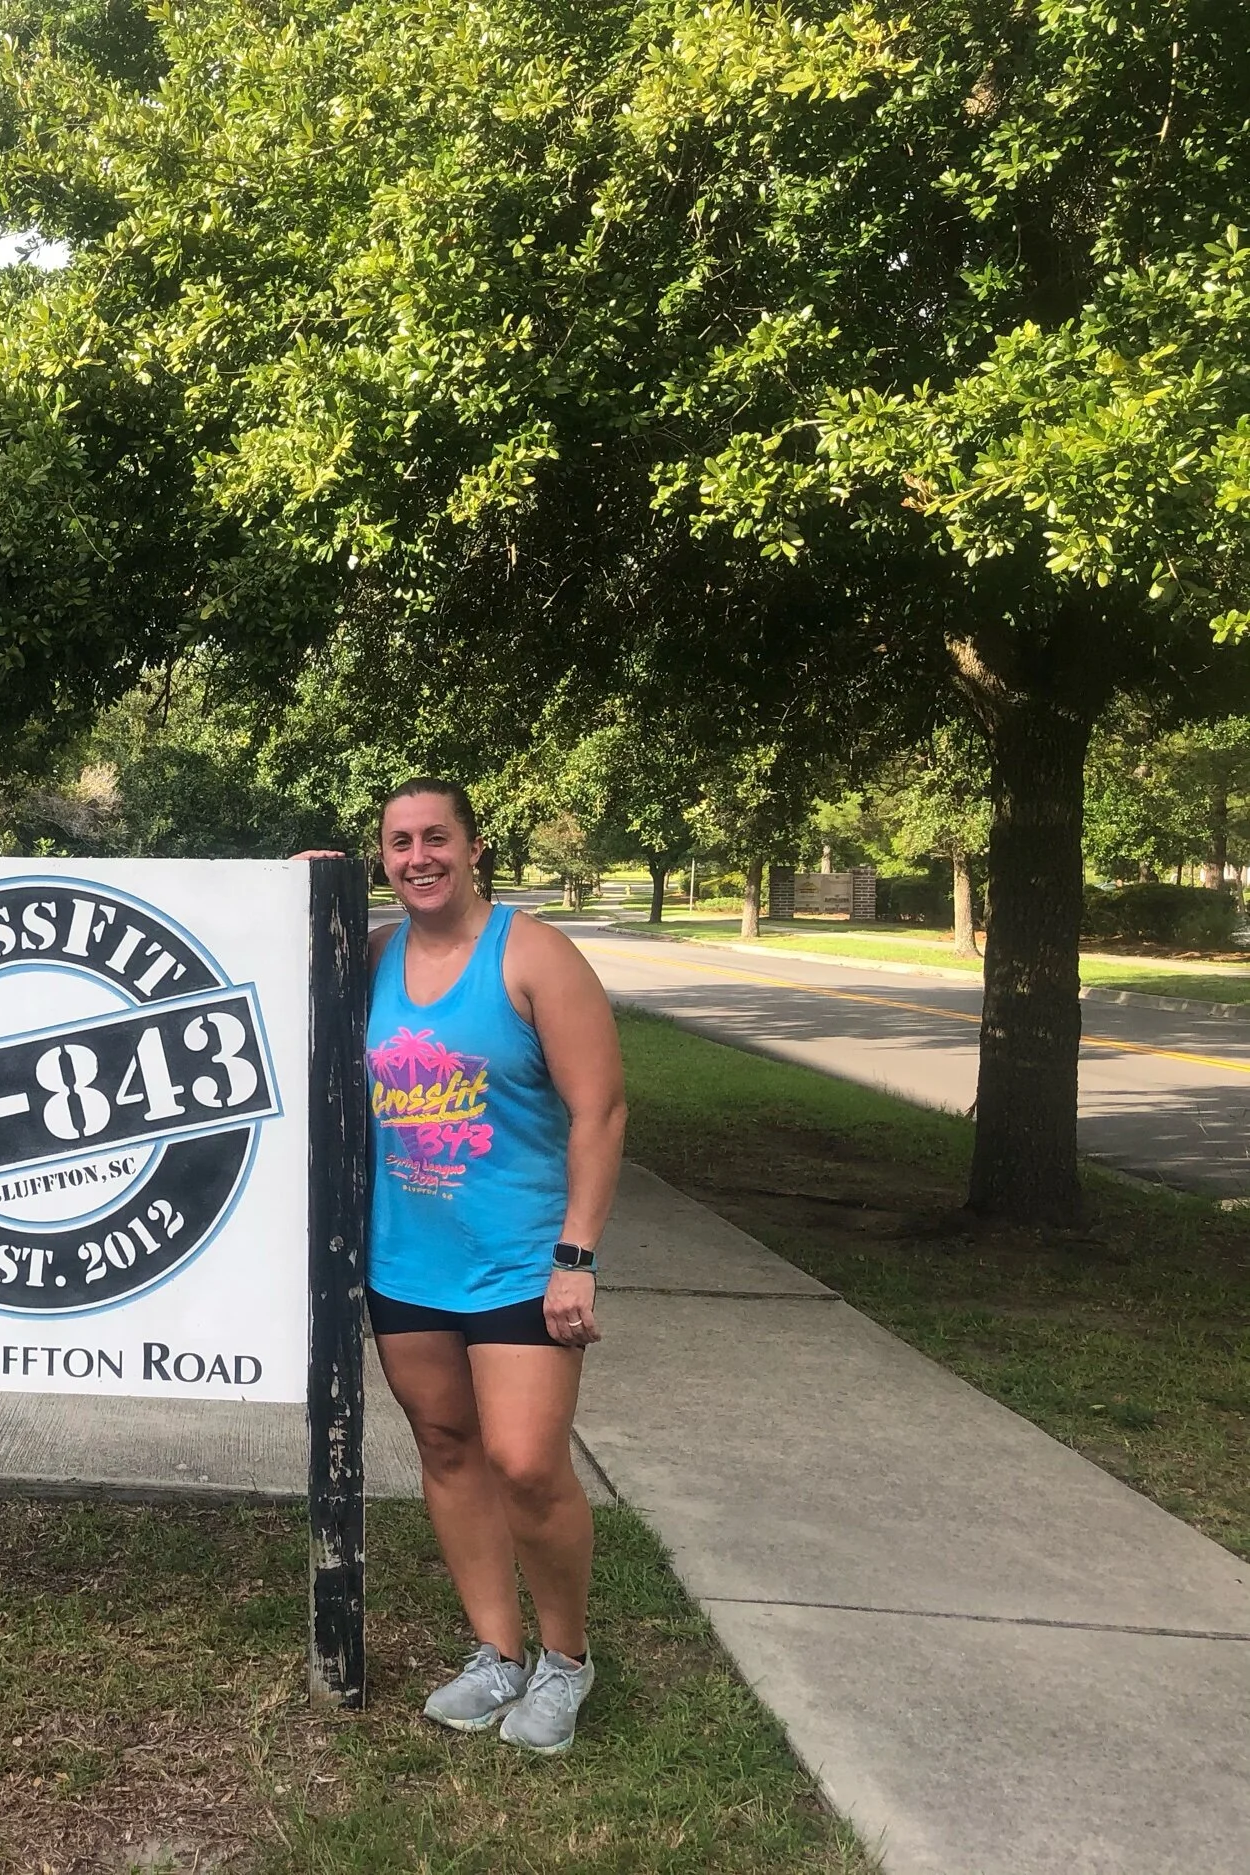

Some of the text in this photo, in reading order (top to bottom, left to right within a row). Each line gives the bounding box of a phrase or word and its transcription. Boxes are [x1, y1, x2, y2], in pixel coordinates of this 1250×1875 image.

[416, 1121, 494, 1160] 843
[109, 1157, 137, 1179] SC
[78, 1200, 185, 1285] 2012
[143, 1343, 262, 1385] ROAD
